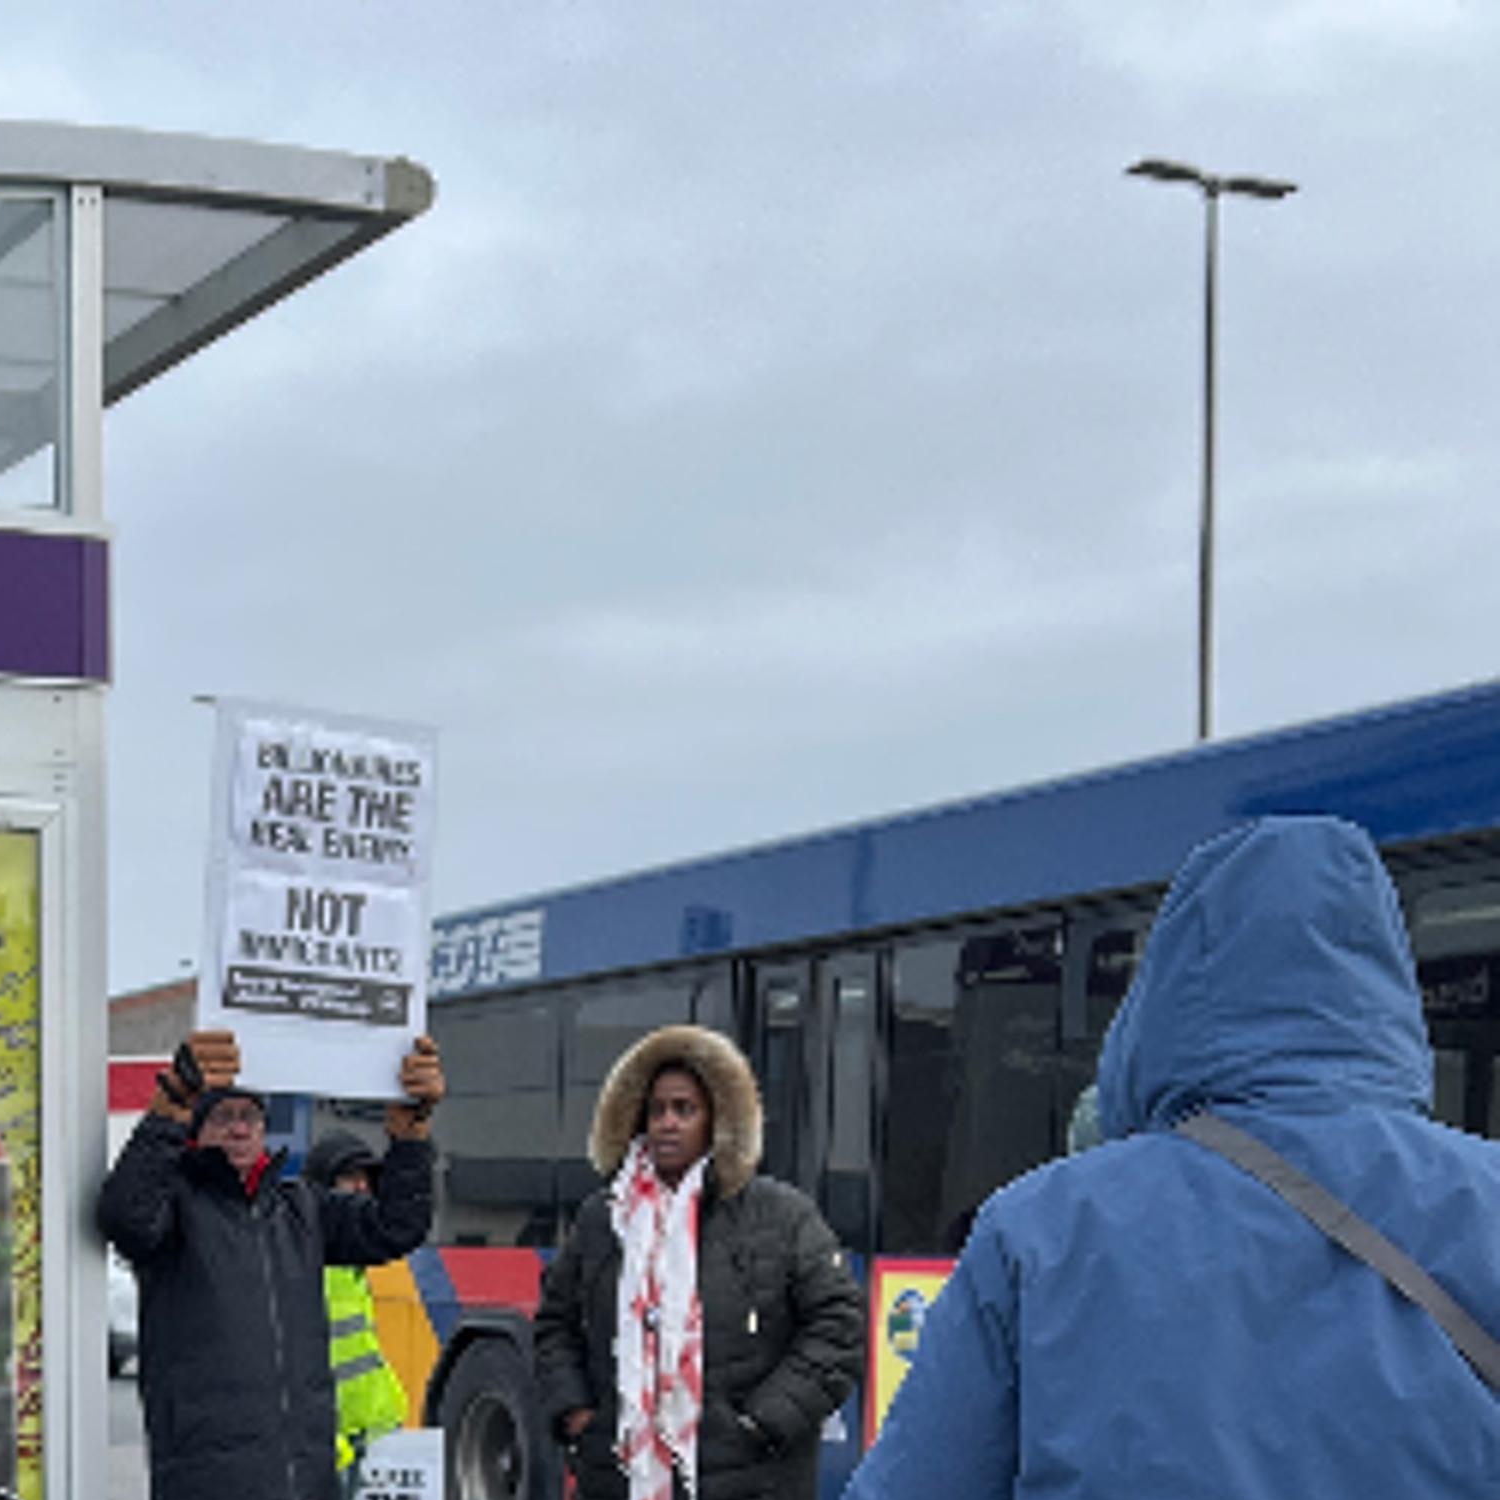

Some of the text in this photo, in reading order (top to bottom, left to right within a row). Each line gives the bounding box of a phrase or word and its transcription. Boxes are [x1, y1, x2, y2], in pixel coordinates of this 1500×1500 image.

[262, 775, 416, 834] ARE THE
[286, 887, 367, 938] NOT
